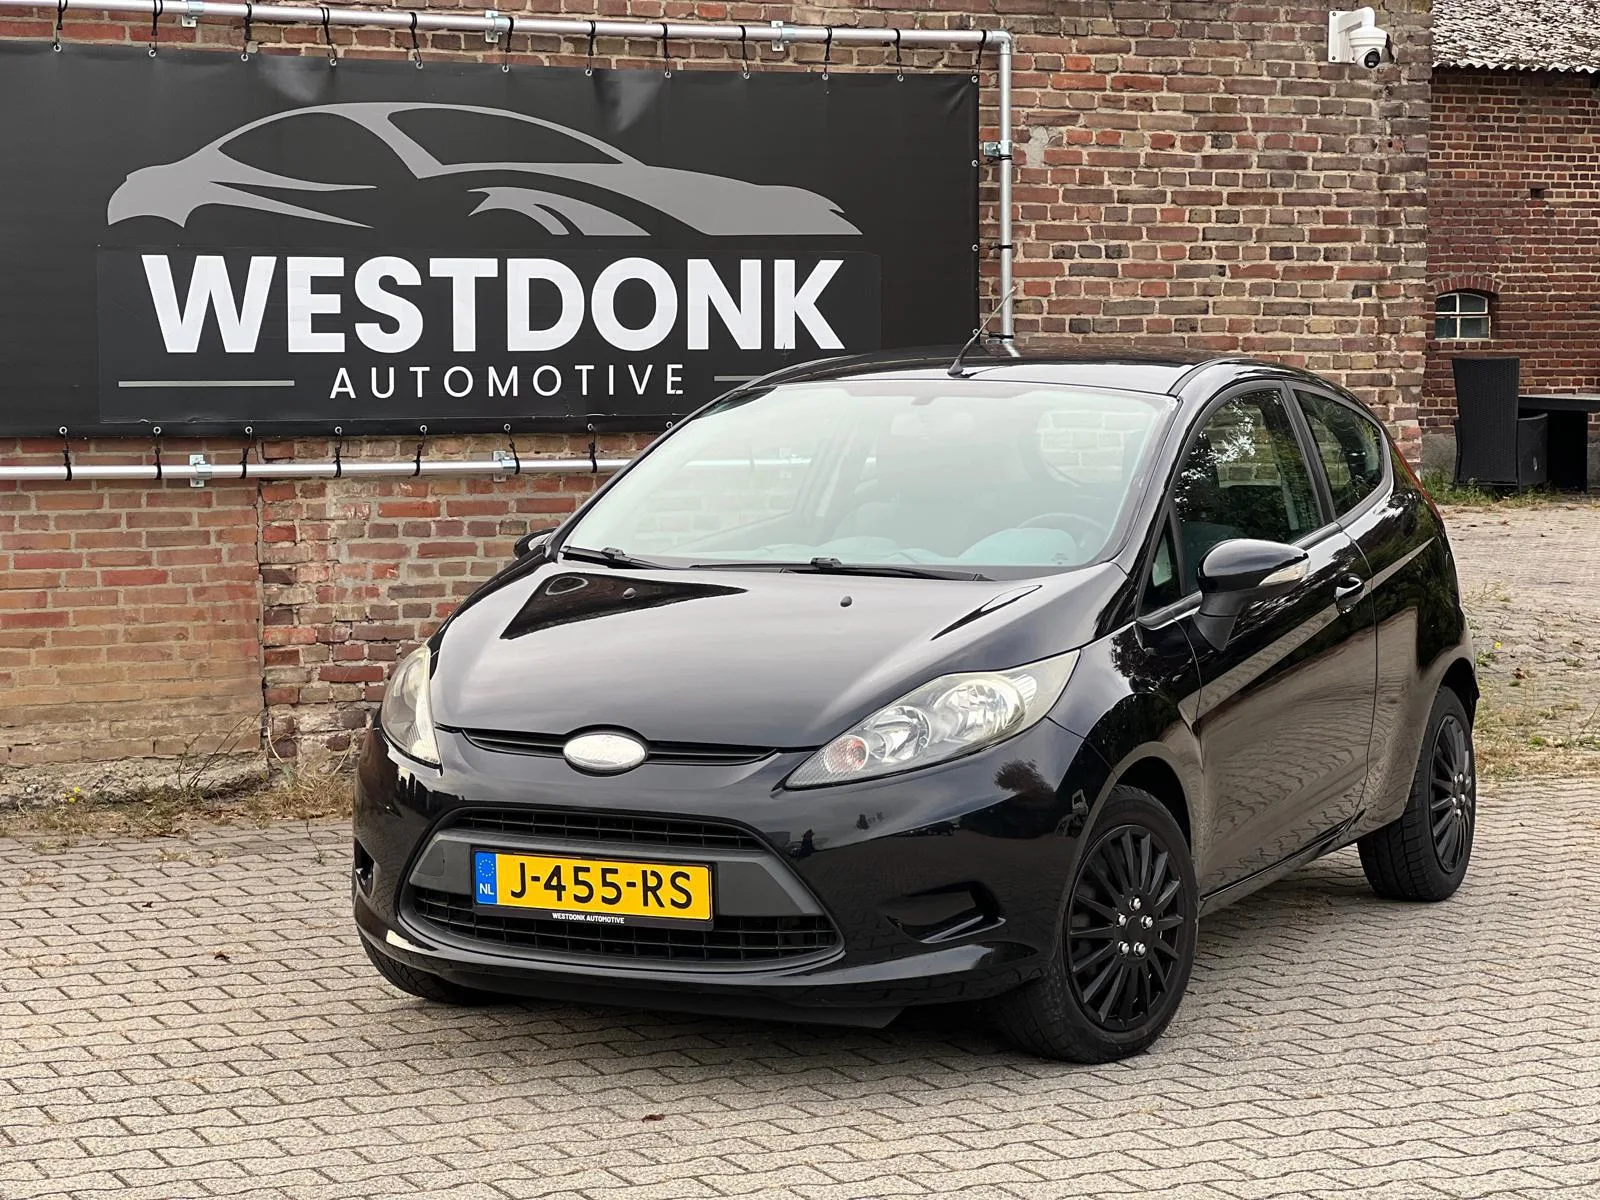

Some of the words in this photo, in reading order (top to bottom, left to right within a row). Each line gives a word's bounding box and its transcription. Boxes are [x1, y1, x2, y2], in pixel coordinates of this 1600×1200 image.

[142, 254, 844, 354] WESTDONK
[330, 364, 685, 399] AUTOMOTIVE
[479, 883, 494, 895] NL
[510, 862, 693, 909] J-455-RS
[552, 912, 585, 921] WESTDONK
[586, 915, 625, 924] AUTOMOTIVE
